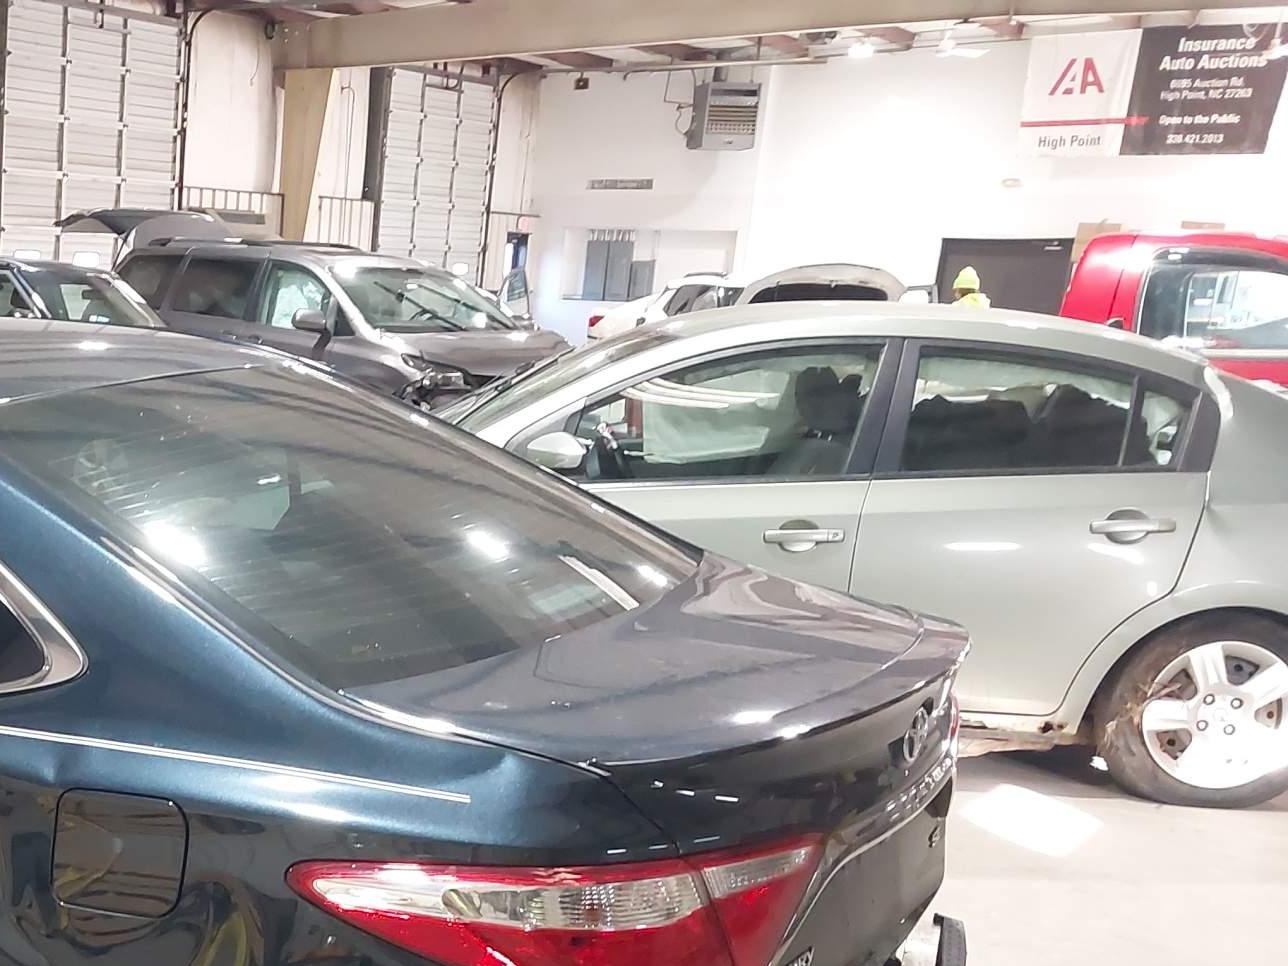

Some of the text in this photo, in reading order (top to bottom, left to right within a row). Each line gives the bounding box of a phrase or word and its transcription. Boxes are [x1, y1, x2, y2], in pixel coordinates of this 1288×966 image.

[1177, 37, 1256, 52] Insurance
[1159, 53, 1268, 70] Auto Auctions
[1159, 113, 1240, 126] Open to the Public
[1038, 134, 1101, 150] High Point
